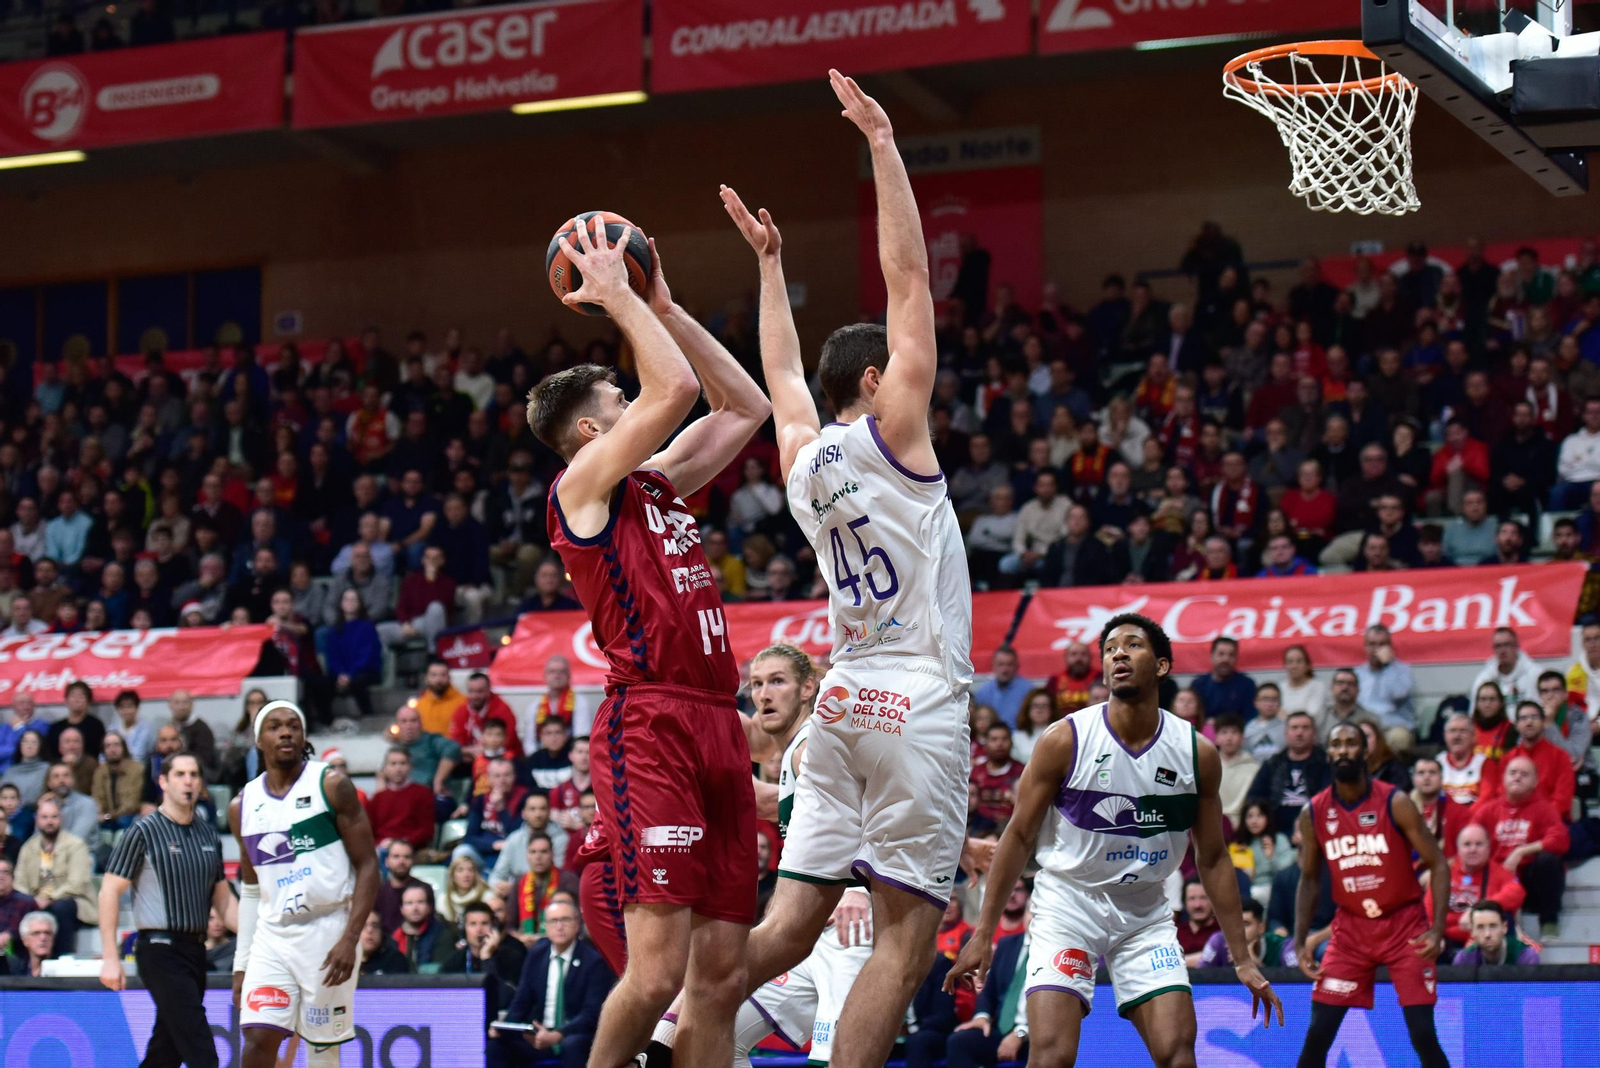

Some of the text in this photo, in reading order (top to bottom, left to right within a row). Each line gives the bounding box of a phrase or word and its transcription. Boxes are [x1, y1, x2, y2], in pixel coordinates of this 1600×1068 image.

[408, 10, 558, 70] caser
[670, 0, 958, 56] COMPRALAENTRADA
[370, 69, 558, 113] Grupo Helvetia
[830, 515, 899, 606] 45
[1164, 575, 1538, 643] CaixaBank
[697, 607, 726, 655] 14
[858, 687, 911, 711] COSTA
[850, 716, 902, 737] MÁLAGA
[852, 703, 907, 723] DEL SOL
[1133, 809, 1165, 823] Unic
[662, 825, 704, 847] ESP
[1325, 833, 1390, 860] UCAM
[1150, 957, 1181, 971] laga
